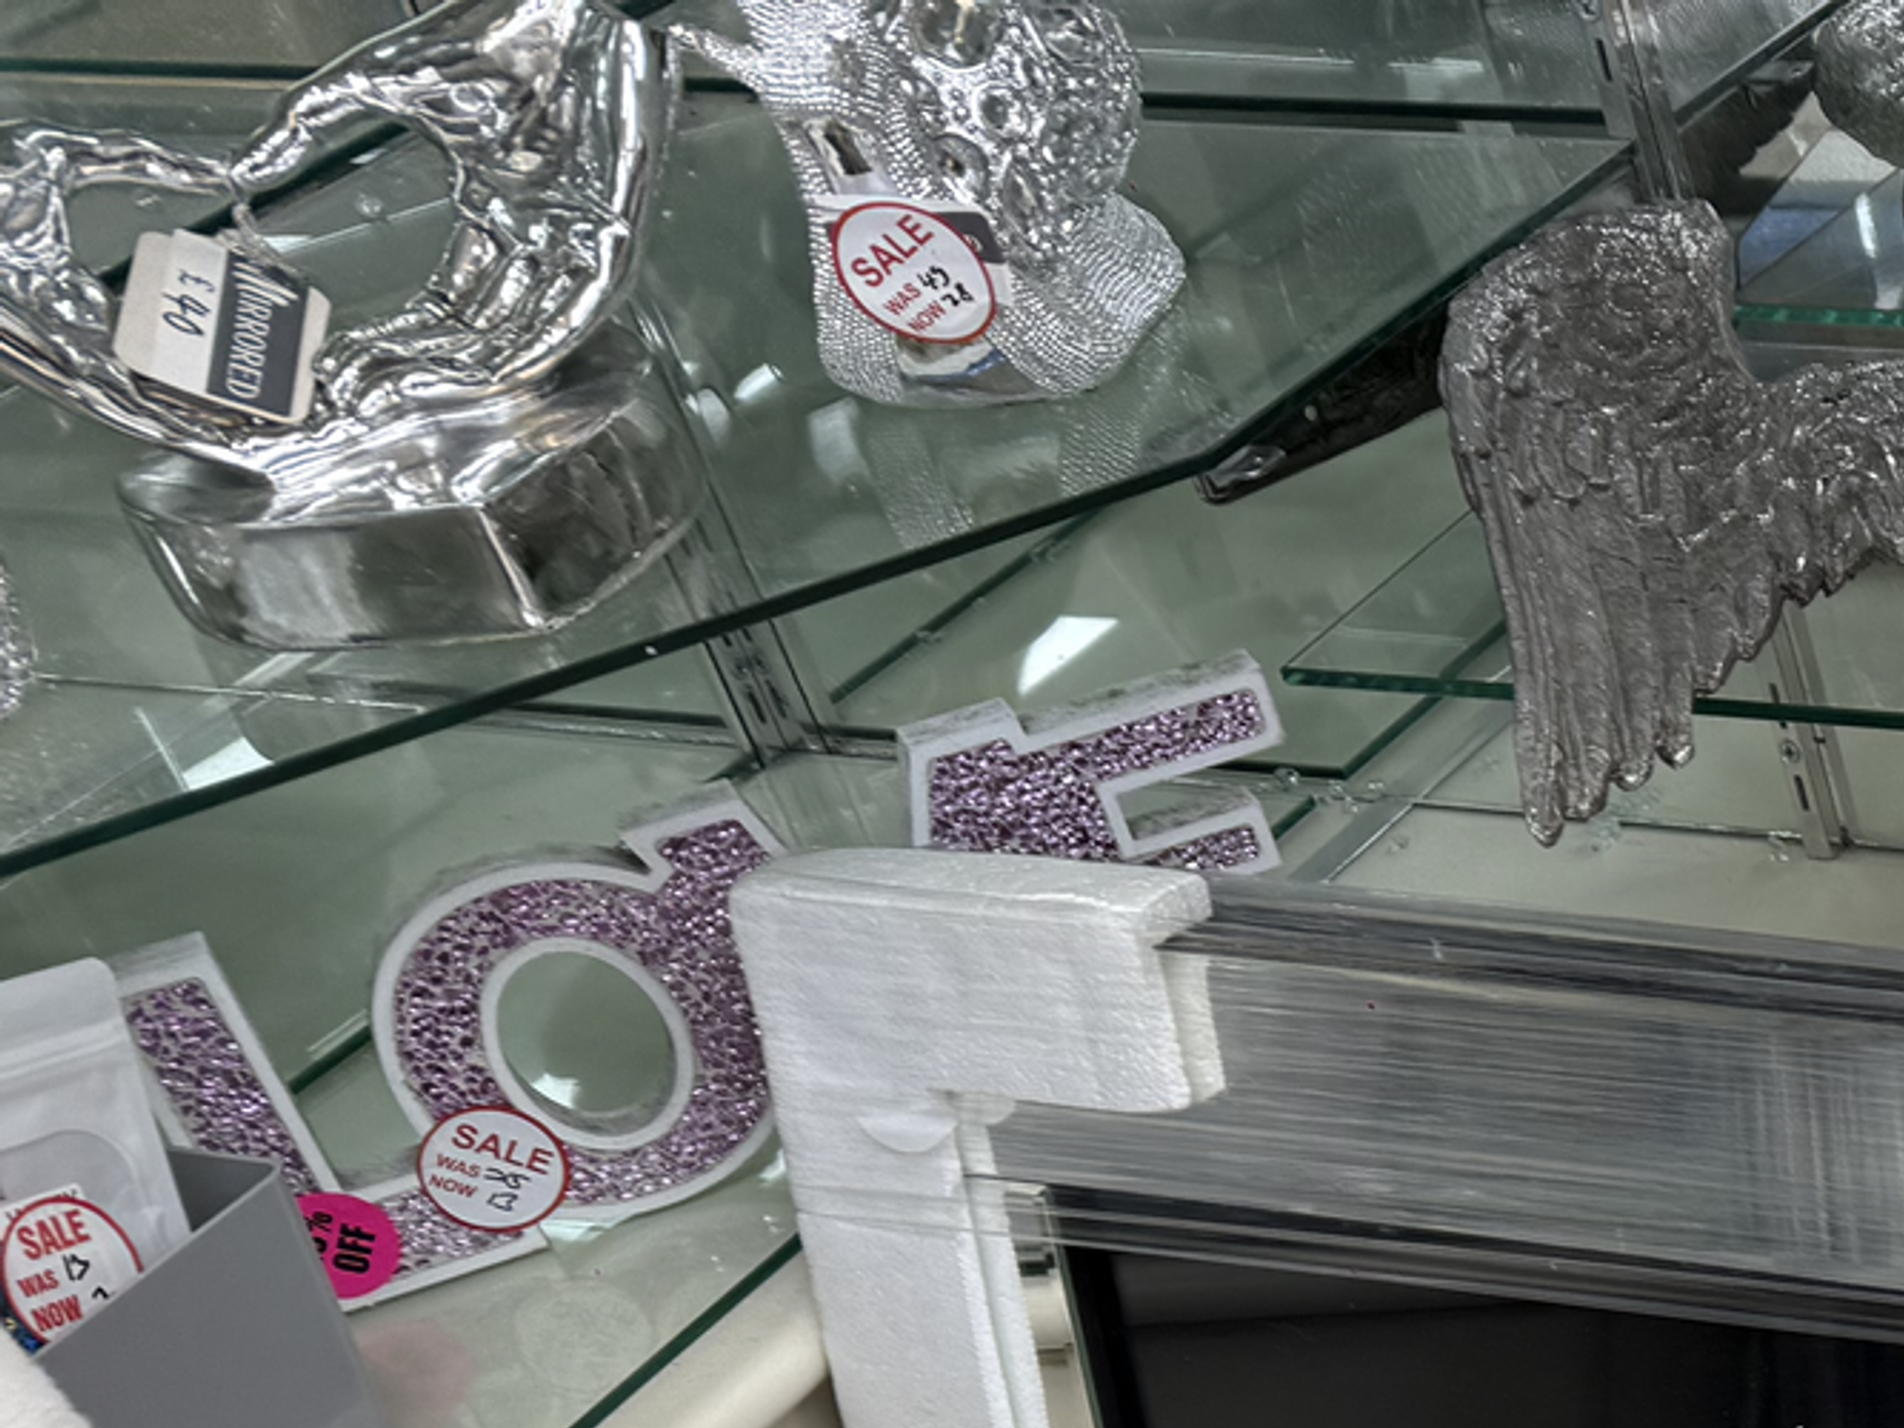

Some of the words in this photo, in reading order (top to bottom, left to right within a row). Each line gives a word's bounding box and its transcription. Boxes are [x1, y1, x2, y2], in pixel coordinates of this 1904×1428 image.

[850, 214, 935, 288] SALE
[883, 282, 922, 315] WAS
[908, 301, 946, 332] NOW
[435, 1153, 482, 1179] WAS
[452, 1123, 554, 1176] SALE
[428, 1174, 478, 1198] NOW
[16, 1208, 92, 1261] SALE
[333, 1223, 376, 1274] OFF
[16, 1269, 60, 1299] WAS
[31, 1294, 84, 1332] NOW
